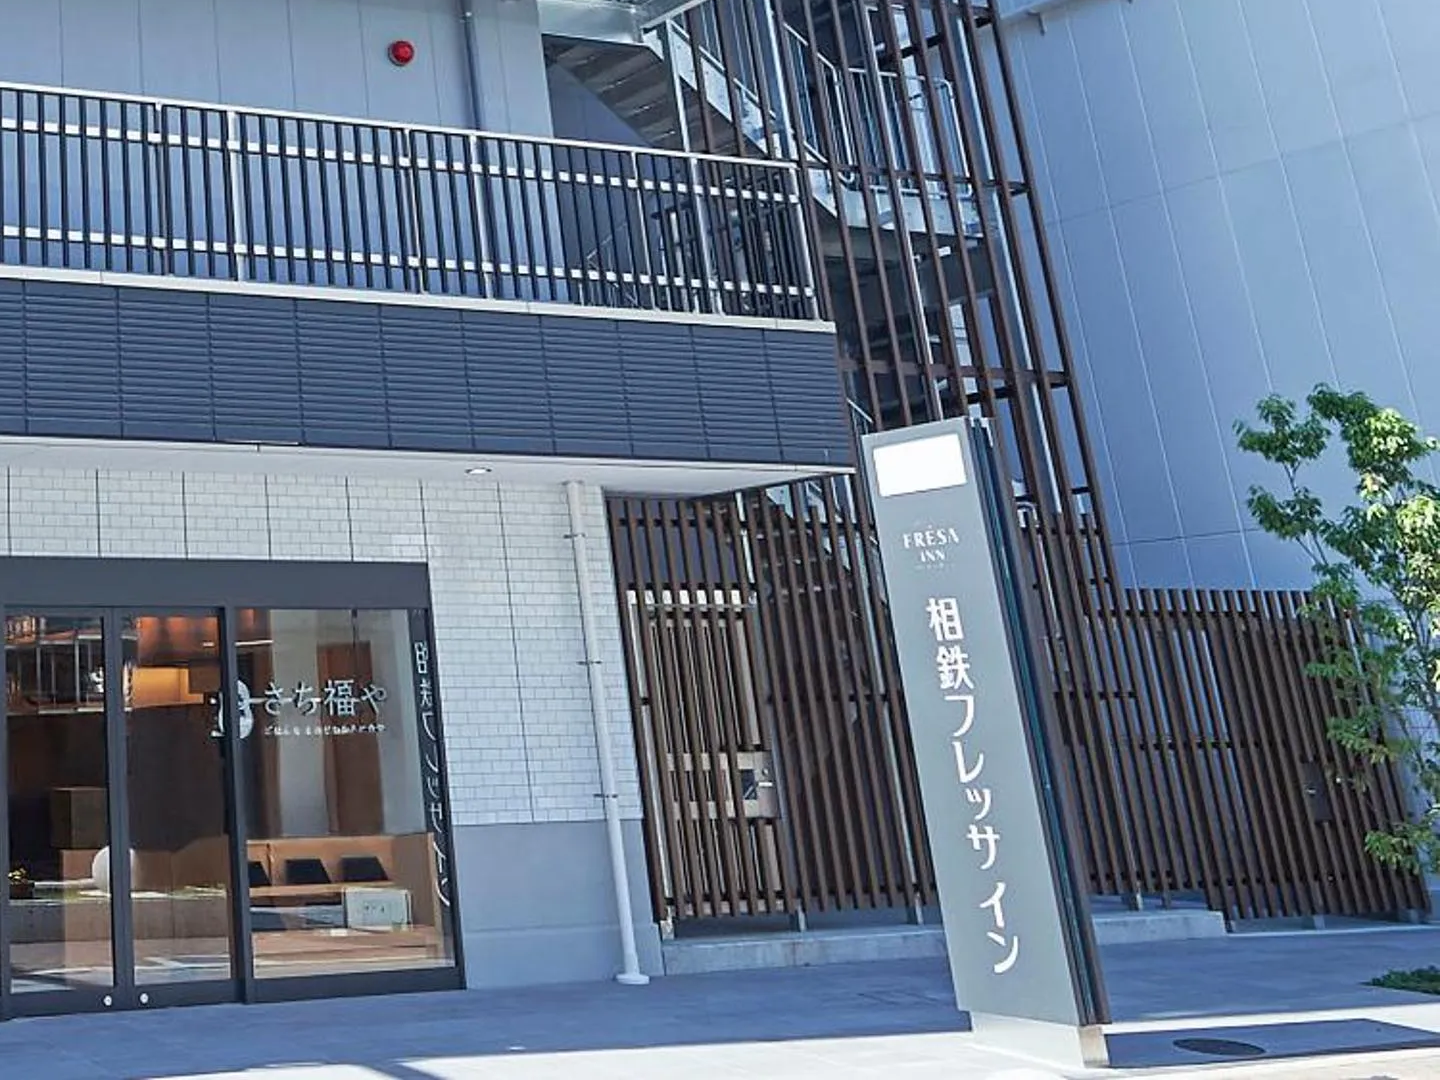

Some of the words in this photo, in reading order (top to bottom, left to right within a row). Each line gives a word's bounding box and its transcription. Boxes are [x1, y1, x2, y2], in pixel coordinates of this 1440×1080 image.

[264, 678, 388, 717] さち福や
[926, 597, 1022, 975] 相鉄フレッサイン
